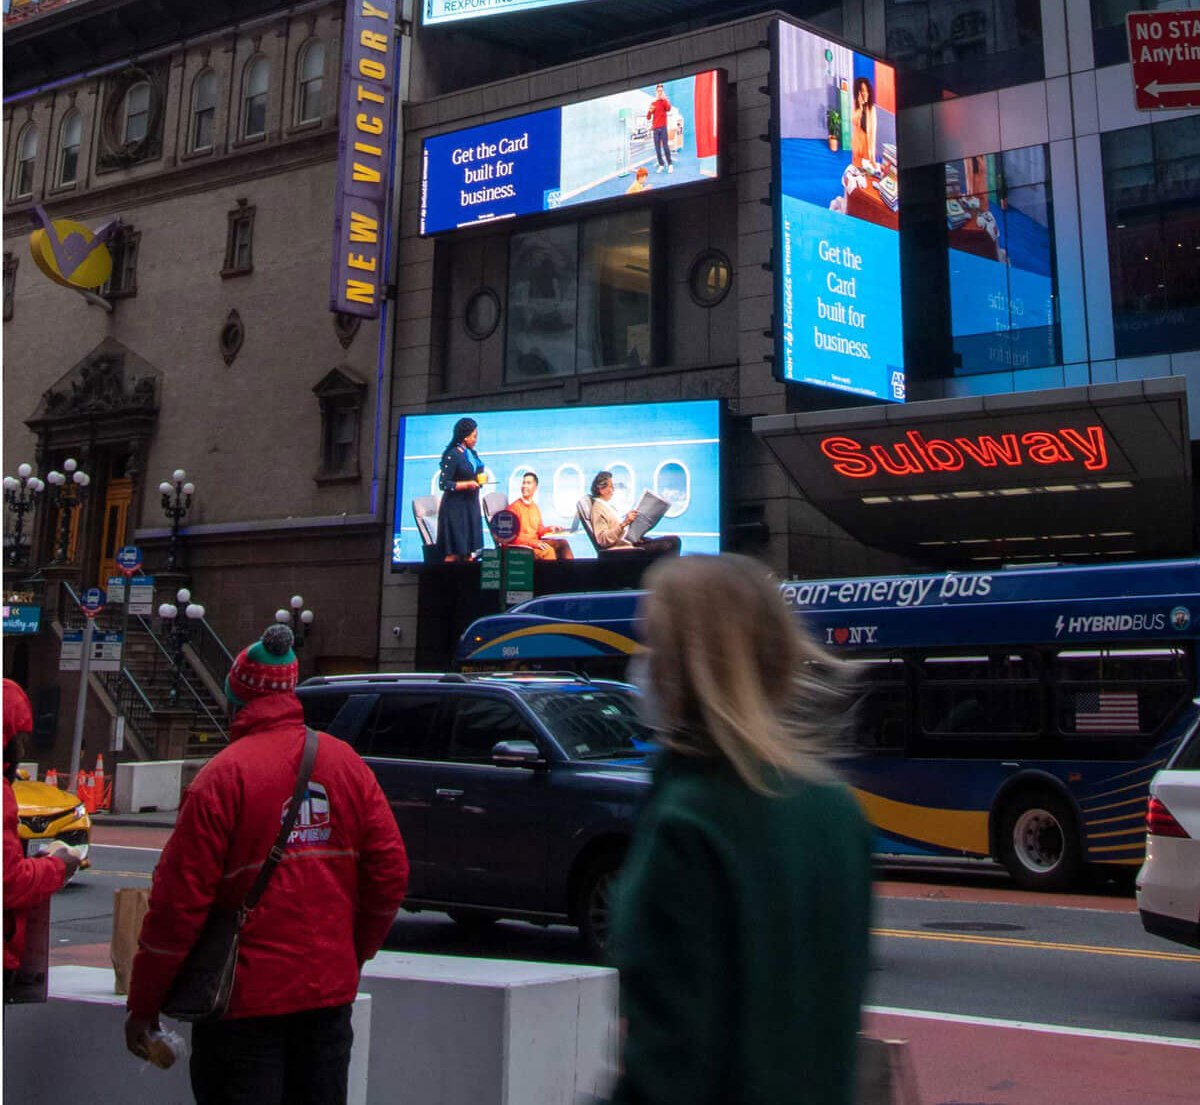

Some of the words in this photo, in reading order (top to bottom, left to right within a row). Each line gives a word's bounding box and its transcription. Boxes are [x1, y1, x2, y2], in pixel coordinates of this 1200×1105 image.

[1135, 22, 1162, 40] NO
[353, 0, 389, 183] VICTORY
[452, 147, 474, 165] Get
[476, 142, 497, 158] the
[498, 133, 529, 154] Card
[464, 164, 493, 184] built
[495, 159, 514, 177] for
[460, 183, 517, 207] business.
[346, 211, 379, 305] NEW
[818, 240, 841, 265] Get
[842, 246, 862, 271] the
[827, 271, 856, 298] Card
[817, 296, 846, 324] built
[848, 305, 866, 328] for
[814, 326, 871, 360] business.
[821, 426, 1109, 478] Subway
[939, 573, 993, 598] bus
[826, 627, 834, 644] I
[848, 626, 878, 643] NY
[1068, 614, 1166, 633] HYBRIDBUS
